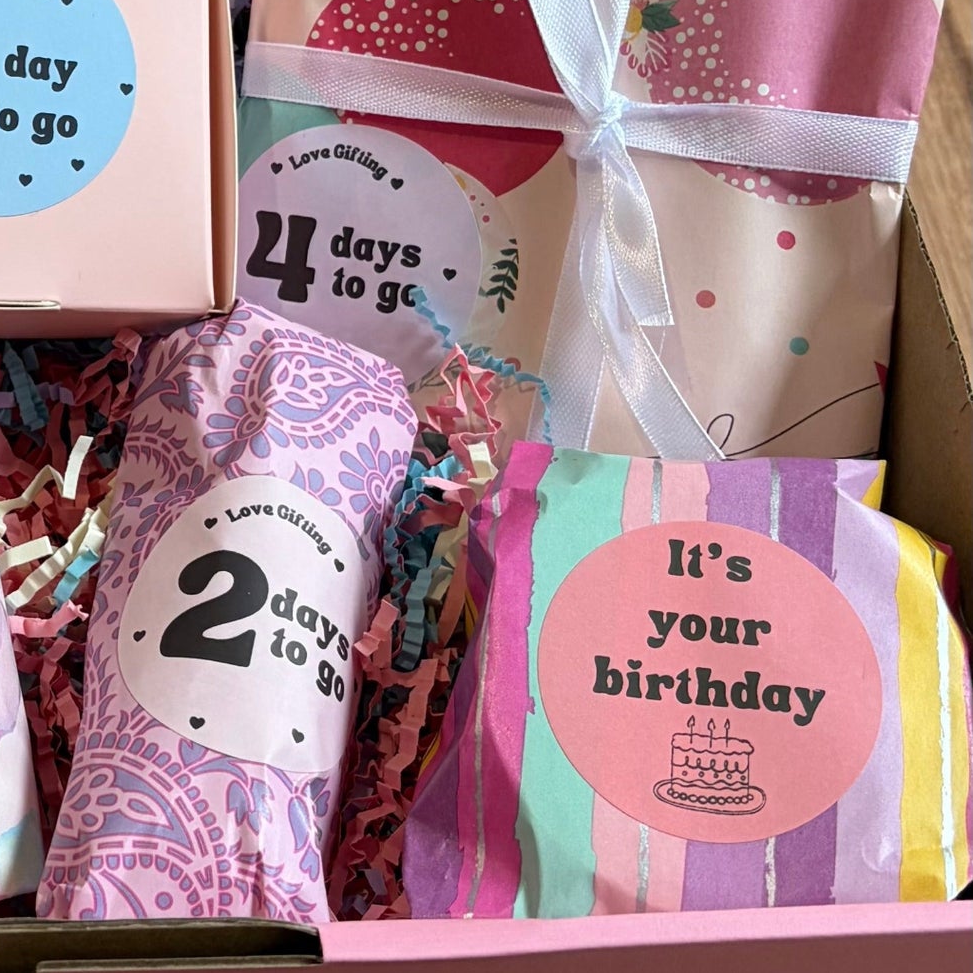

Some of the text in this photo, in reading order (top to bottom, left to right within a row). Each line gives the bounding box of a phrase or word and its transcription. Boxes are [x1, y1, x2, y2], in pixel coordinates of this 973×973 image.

[4, 45, 78, 90] day
[31, 112, 79, 145] go
[288, 143, 388, 181] Love Gifting
[245, 210, 317, 303] 4
[330, 226, 422, 274] days
[331, 266, 366, 299] to
[225, 504, 332, 555] Love Gifting
[667, 539, 752, 582] It's
[159, 549, 269, 668] 2
[270, 588, 350, 661] days
[647, 609, 772, 649] your
[270, 628, 345, 703] to go
[593, 655, 826, 727] birthday
